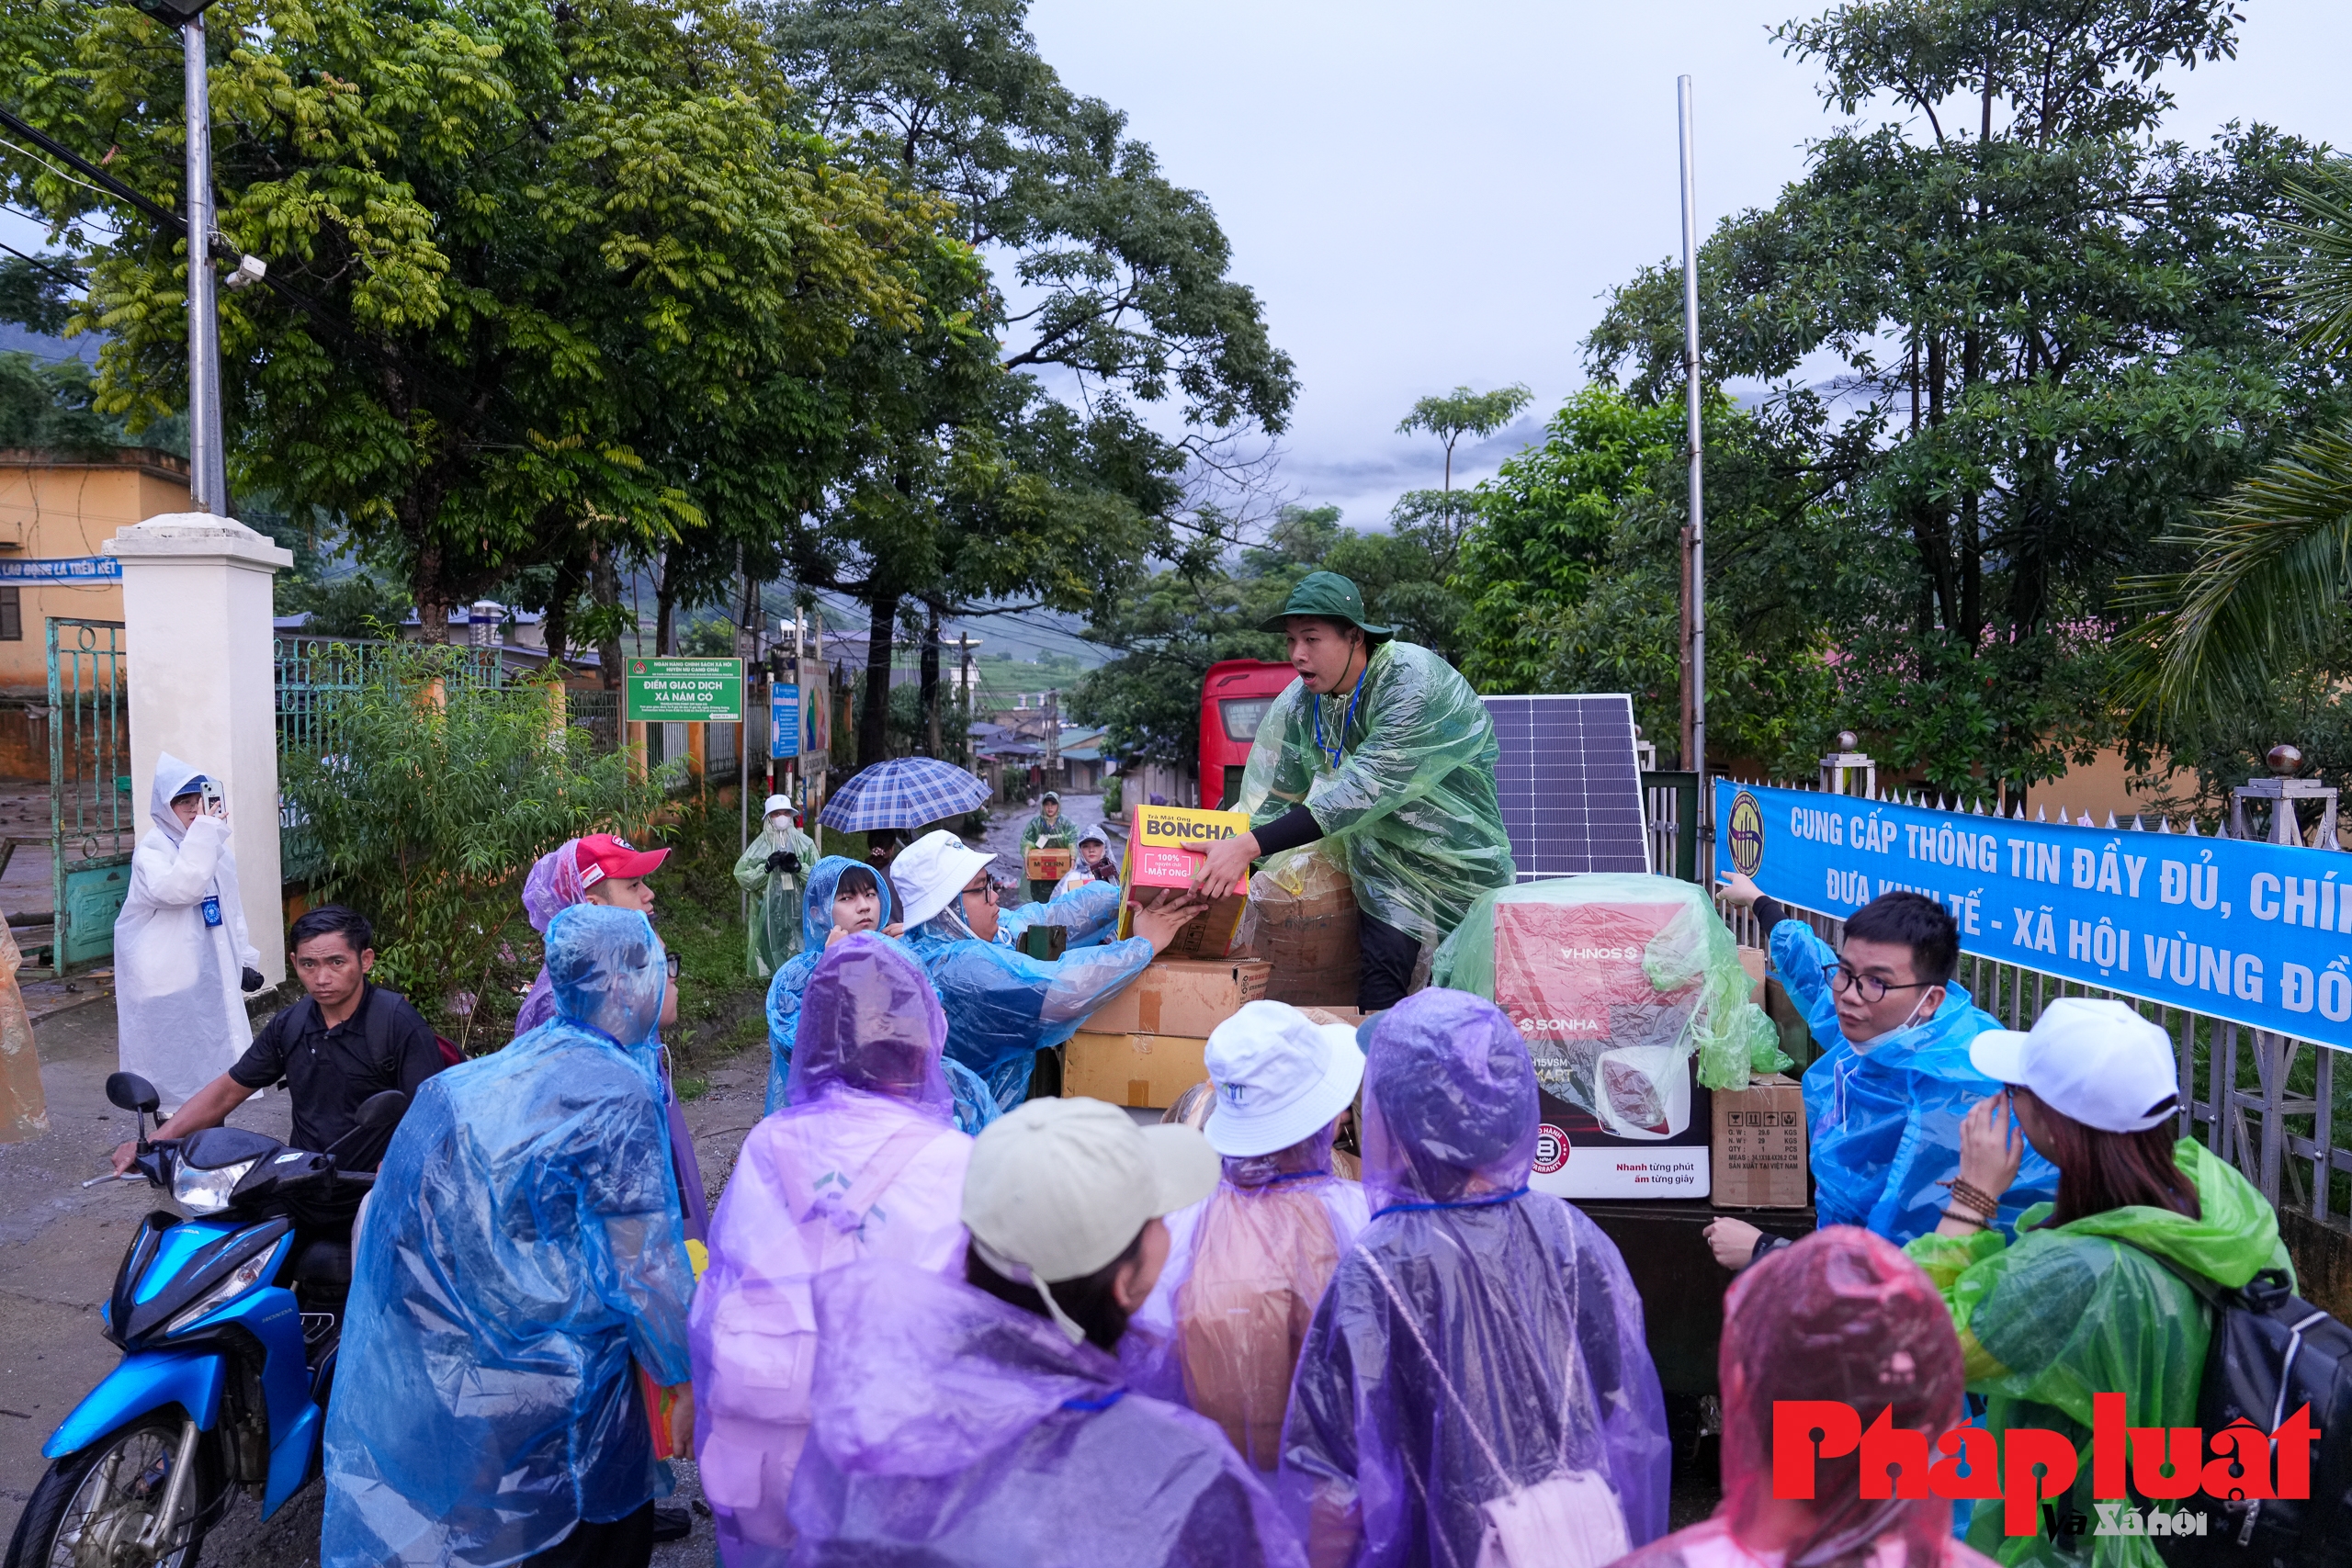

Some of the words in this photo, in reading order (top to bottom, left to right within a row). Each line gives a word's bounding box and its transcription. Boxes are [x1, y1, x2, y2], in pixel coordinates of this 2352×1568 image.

[643, 679, 667, 689] ĐIỂM
[669, 681, 696, 689] GIAO
[698, 681, 723, 690] DỊCH
[655, 691, 669, 701] XÃ
[672, 691, 695, 702] NẬM
[697, 691, 713, 701] CÓ
[1147, 820, 1235, 840] BONCHA
[1158, 853, 1179, 862] 100%
[1148, 867, 1166, 877] MẬT
[1168, 869, 1187, 877] ONG
[1791, 807, 1843, 846] CUNG
[1850, 807, 1898, 854] CẤP
[1905, 822, 1997, 874] THÔNG
[2007, 838, 2061, 885] TIN
[2071, 837, 2148, 898] ĐẦY
[2160, 849, 2232, 919] ĐỦ,
[2250, 870, 2352, 935] CHÍ
[1826, 868, 1870, 908] ĐƯA
[1949, 887, 1984, 936] TẾ
[2013, 905, 2057, 955] XÃ
[2069, 916, 2130, 977] HỘI
[2144, 930, 2263, 1004] VÙNG
[1561, 948, 1623, 959] SONHA
[1536, 1019, 1598, 1031] SONHA
[1543, 1127, 1562, 1140] HÀNH
[1536, 1140, 1555, 1157] 8
[1649, 1163, 1671, 1172] từng
[1673, 1162, 1694, 1172] phút
[1743, 1160, 1758, 1169] XUẤT
[1770, 1161, 1783, 1170] VIỆT
[1635, 1175, 1649, 1183] ấm
[1651, 1175, 1673, 1184] từng
[1675, 1175, 1694, 1184] giây
[262, 1308, 293, 1323] HONDA
